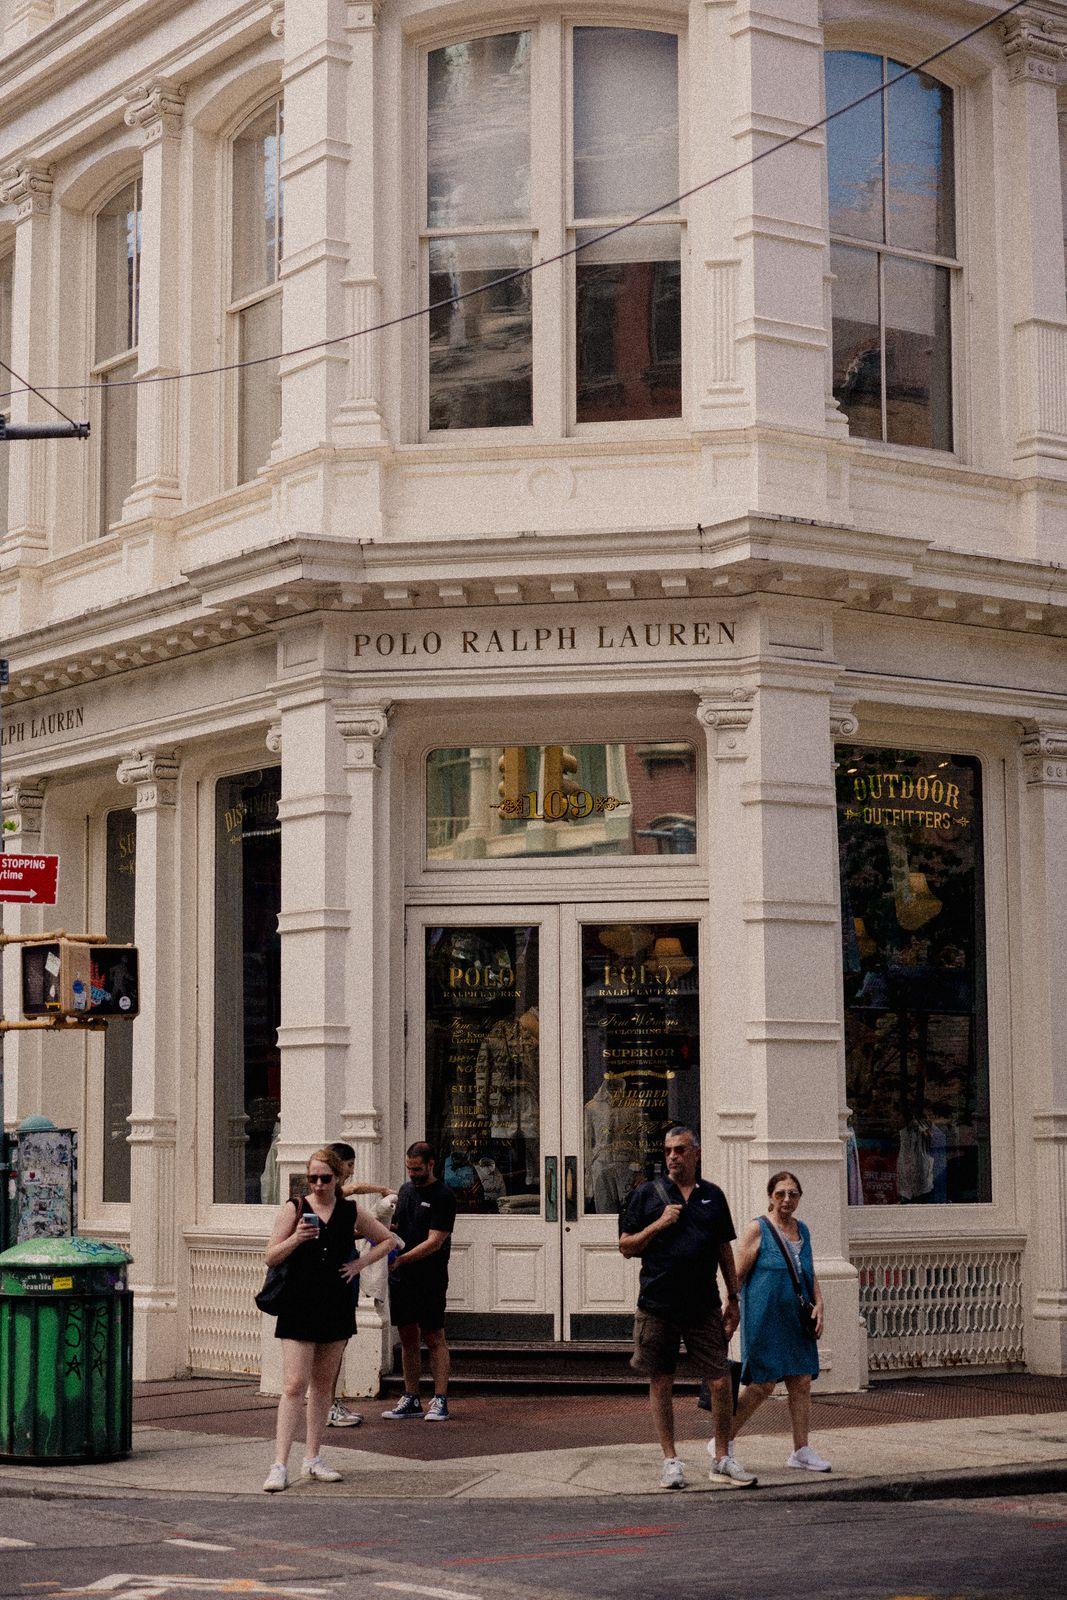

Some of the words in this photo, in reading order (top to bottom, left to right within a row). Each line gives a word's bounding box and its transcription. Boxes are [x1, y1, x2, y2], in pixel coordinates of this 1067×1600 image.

[353, 631, 442, 657] POLO
[461, 627, 577, 653] RALPH
[597, 621, 738, 649] LAUREN
[31, 706, 84, 738] LAUREN
[853, 773, 960, 810] OUTDOOR
[522, 789, 595, 820] 109
[863, 807, 951, 830] OUTFITTERS
[1, 858, 46, 870] STOPPING
[449, 965, 514, 989] POLO
[604, 965, 672, 986] POLO
[602, 1048, 675, 1058] SUPERIOR
